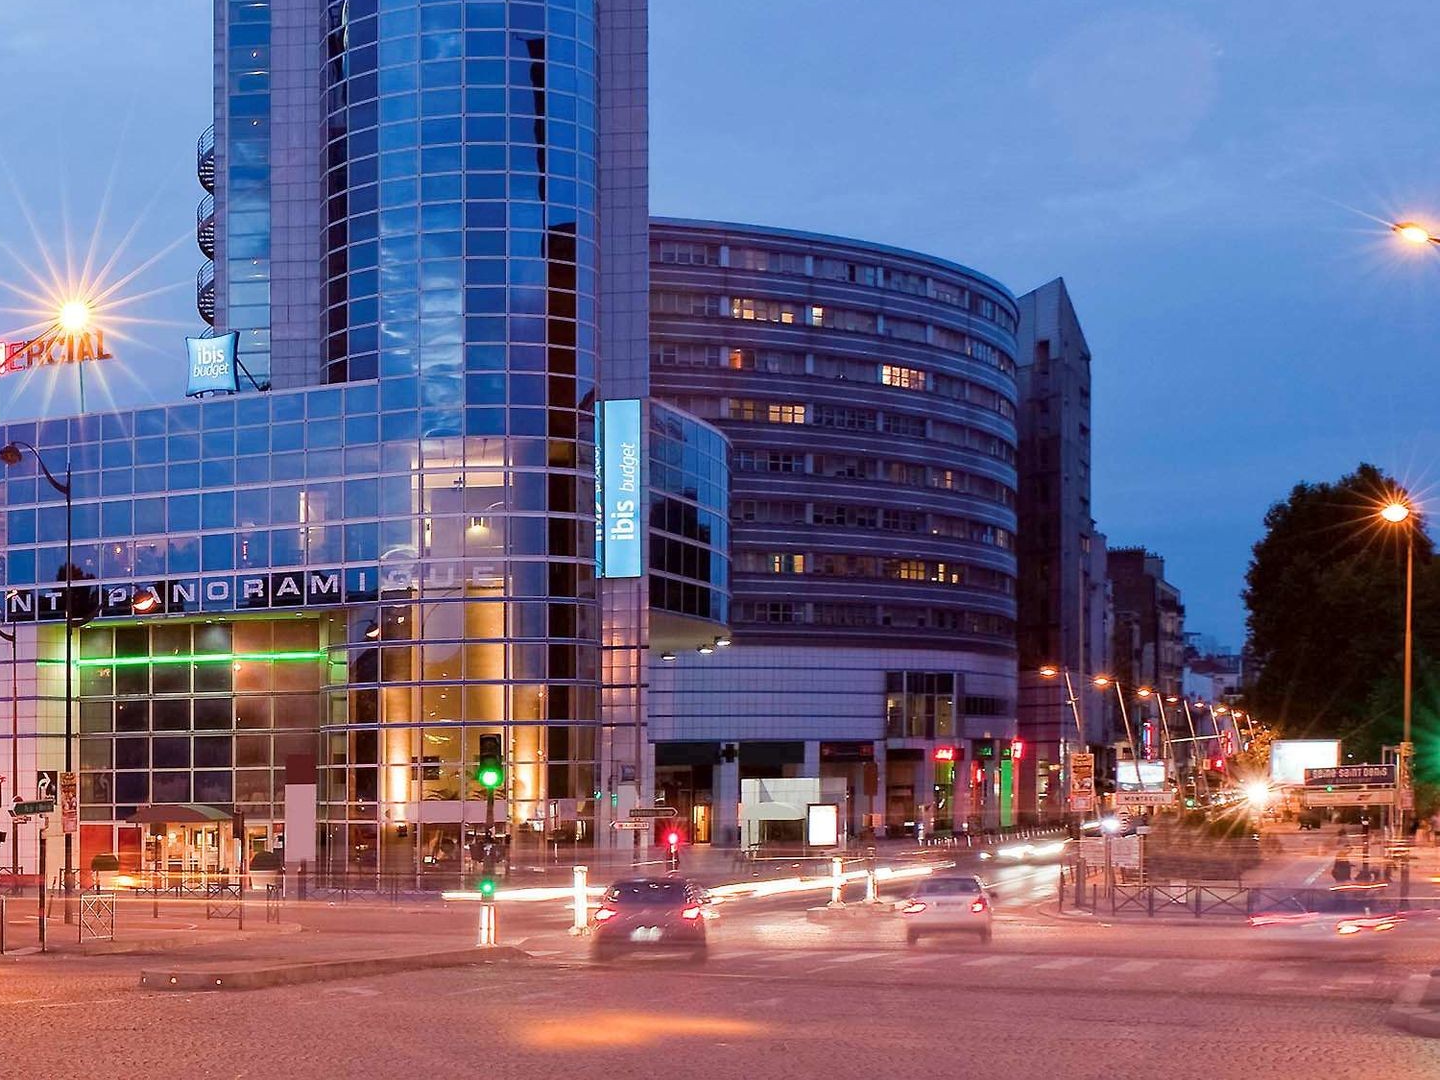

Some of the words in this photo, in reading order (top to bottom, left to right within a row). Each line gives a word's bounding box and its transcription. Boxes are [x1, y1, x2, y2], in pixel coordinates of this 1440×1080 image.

[193, 362, 230, 379] budget
[197, 346, 225, 365] ibis
[618, 441, 639, 492] budget
[610, 500, 635, 541] ibis
